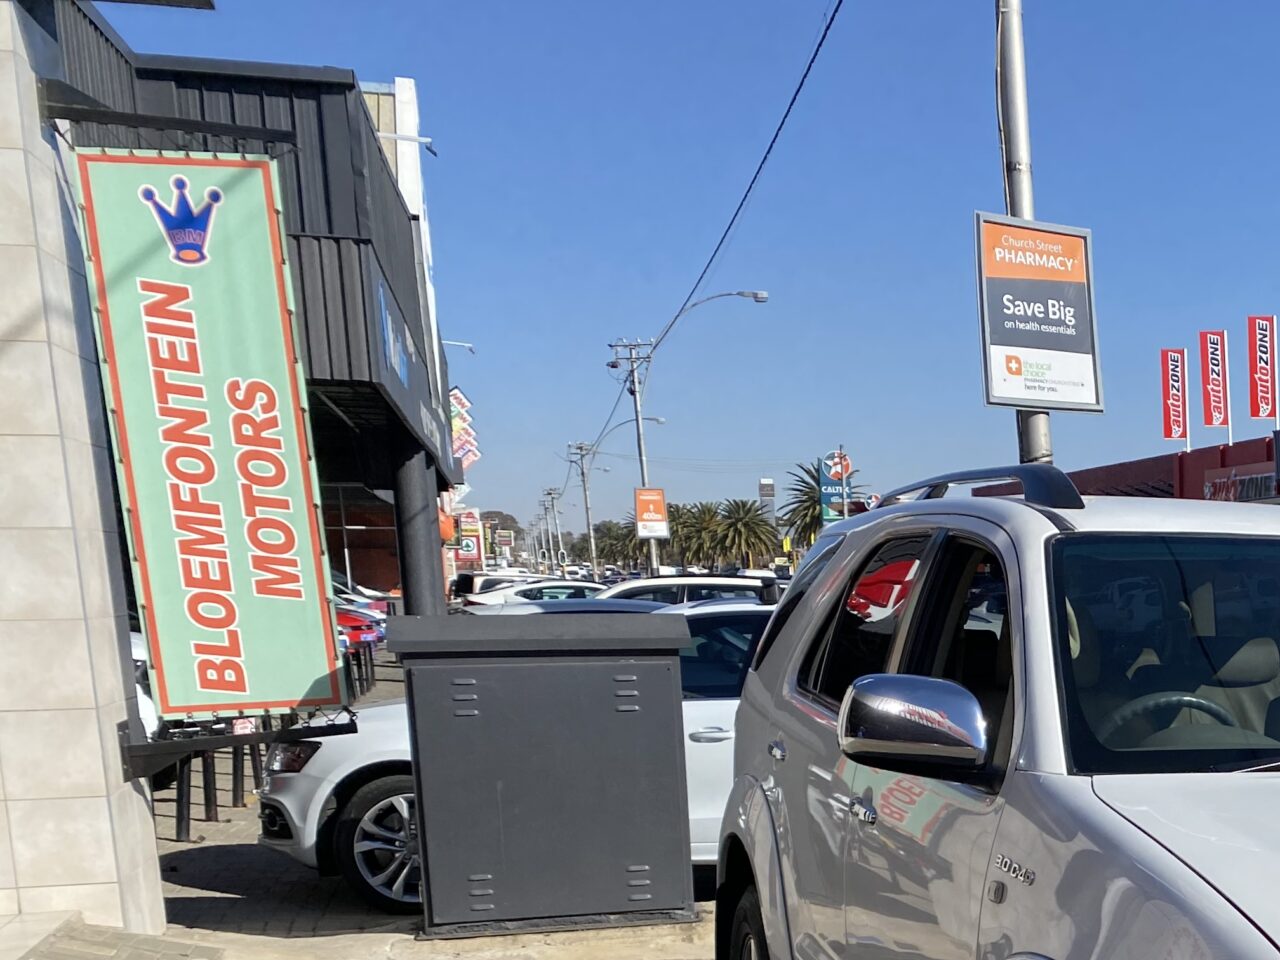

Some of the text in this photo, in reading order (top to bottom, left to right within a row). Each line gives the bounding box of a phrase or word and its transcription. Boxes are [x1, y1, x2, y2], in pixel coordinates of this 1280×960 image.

[169, 228, 204, 245] BM
[1001, 235, 1063, 254] Church Street
[994, 247, 1073, 271] PHARMACY
[1002, 294, 1076, 325] Save Big
[1004, 319, 1076, 336] on health essentials
[1035, 361, 1052, 371] local
[138, 278, 250, 695] BLOEMFONTEIN
[225, 378, 304, 600] MOTORS
[821, 486, 850, 494] CALTX
